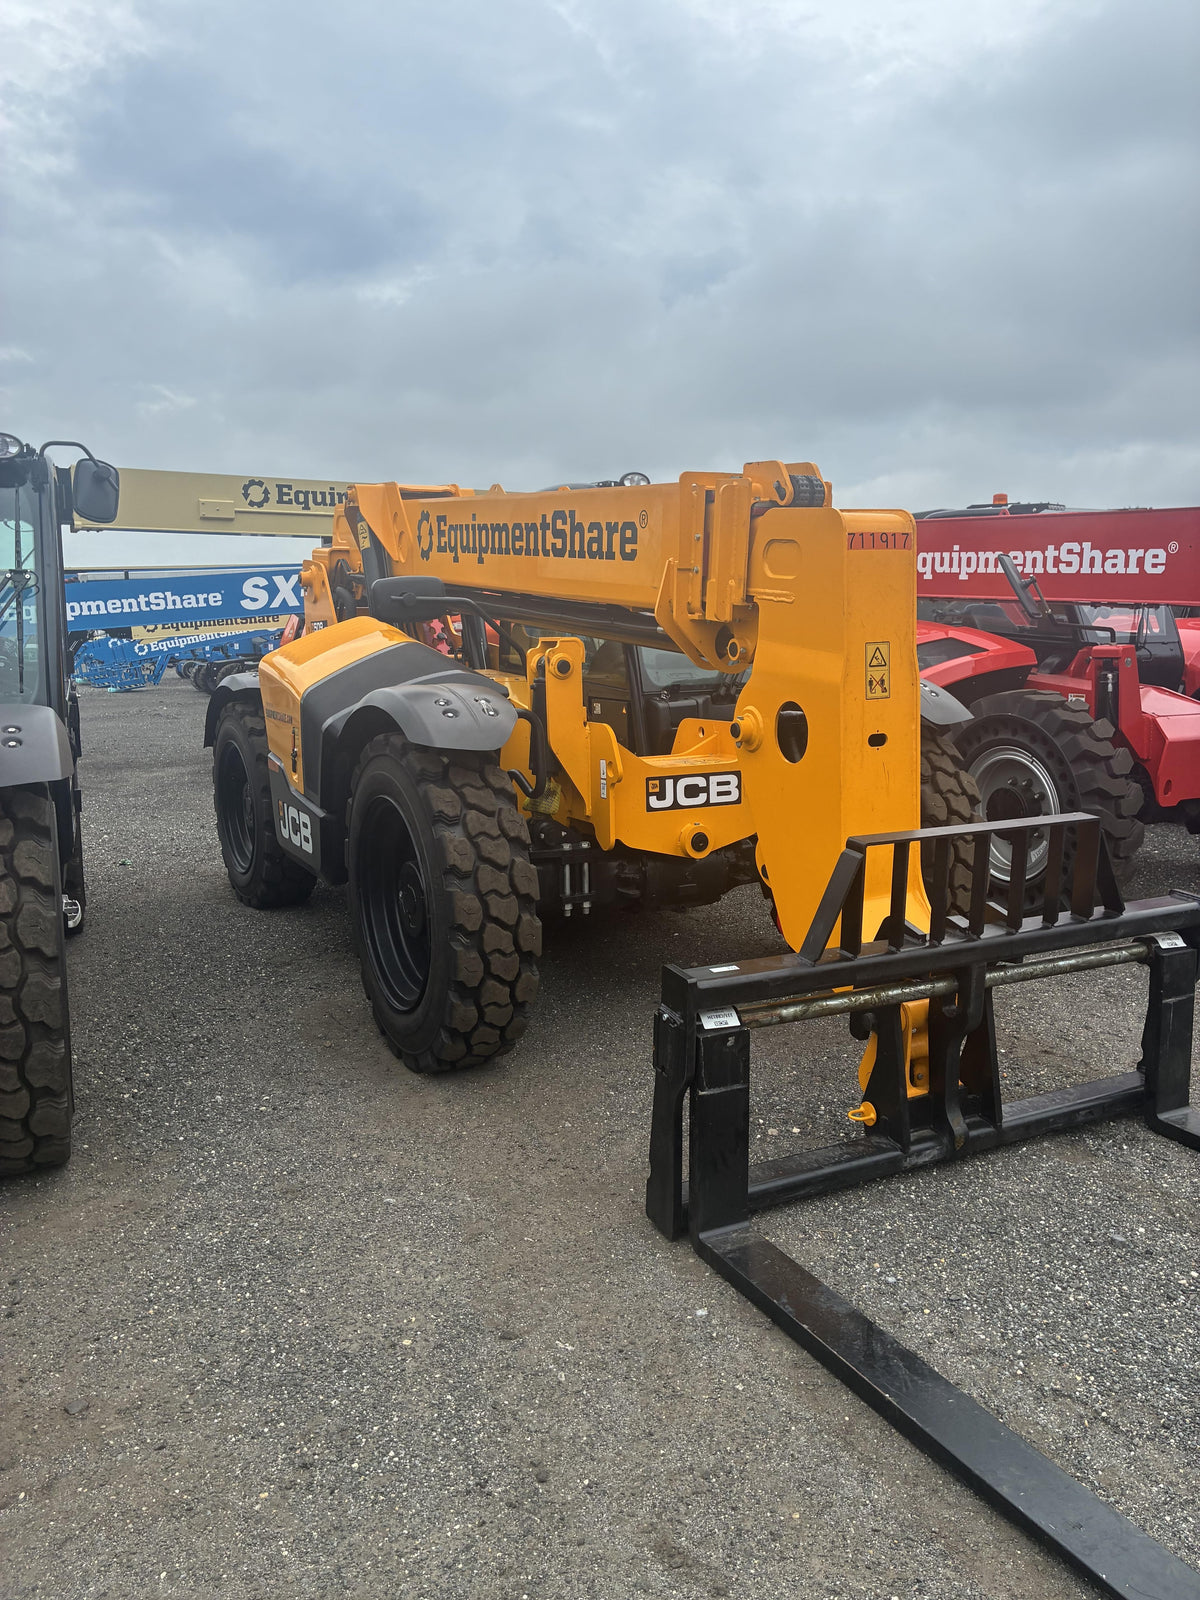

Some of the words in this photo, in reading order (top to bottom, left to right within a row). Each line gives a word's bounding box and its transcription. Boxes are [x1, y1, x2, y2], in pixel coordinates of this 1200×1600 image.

[848, 532, 910, 549] 711917
[649, 774, 740, 809] JCB
[280, 803, 313, 854] JCB
